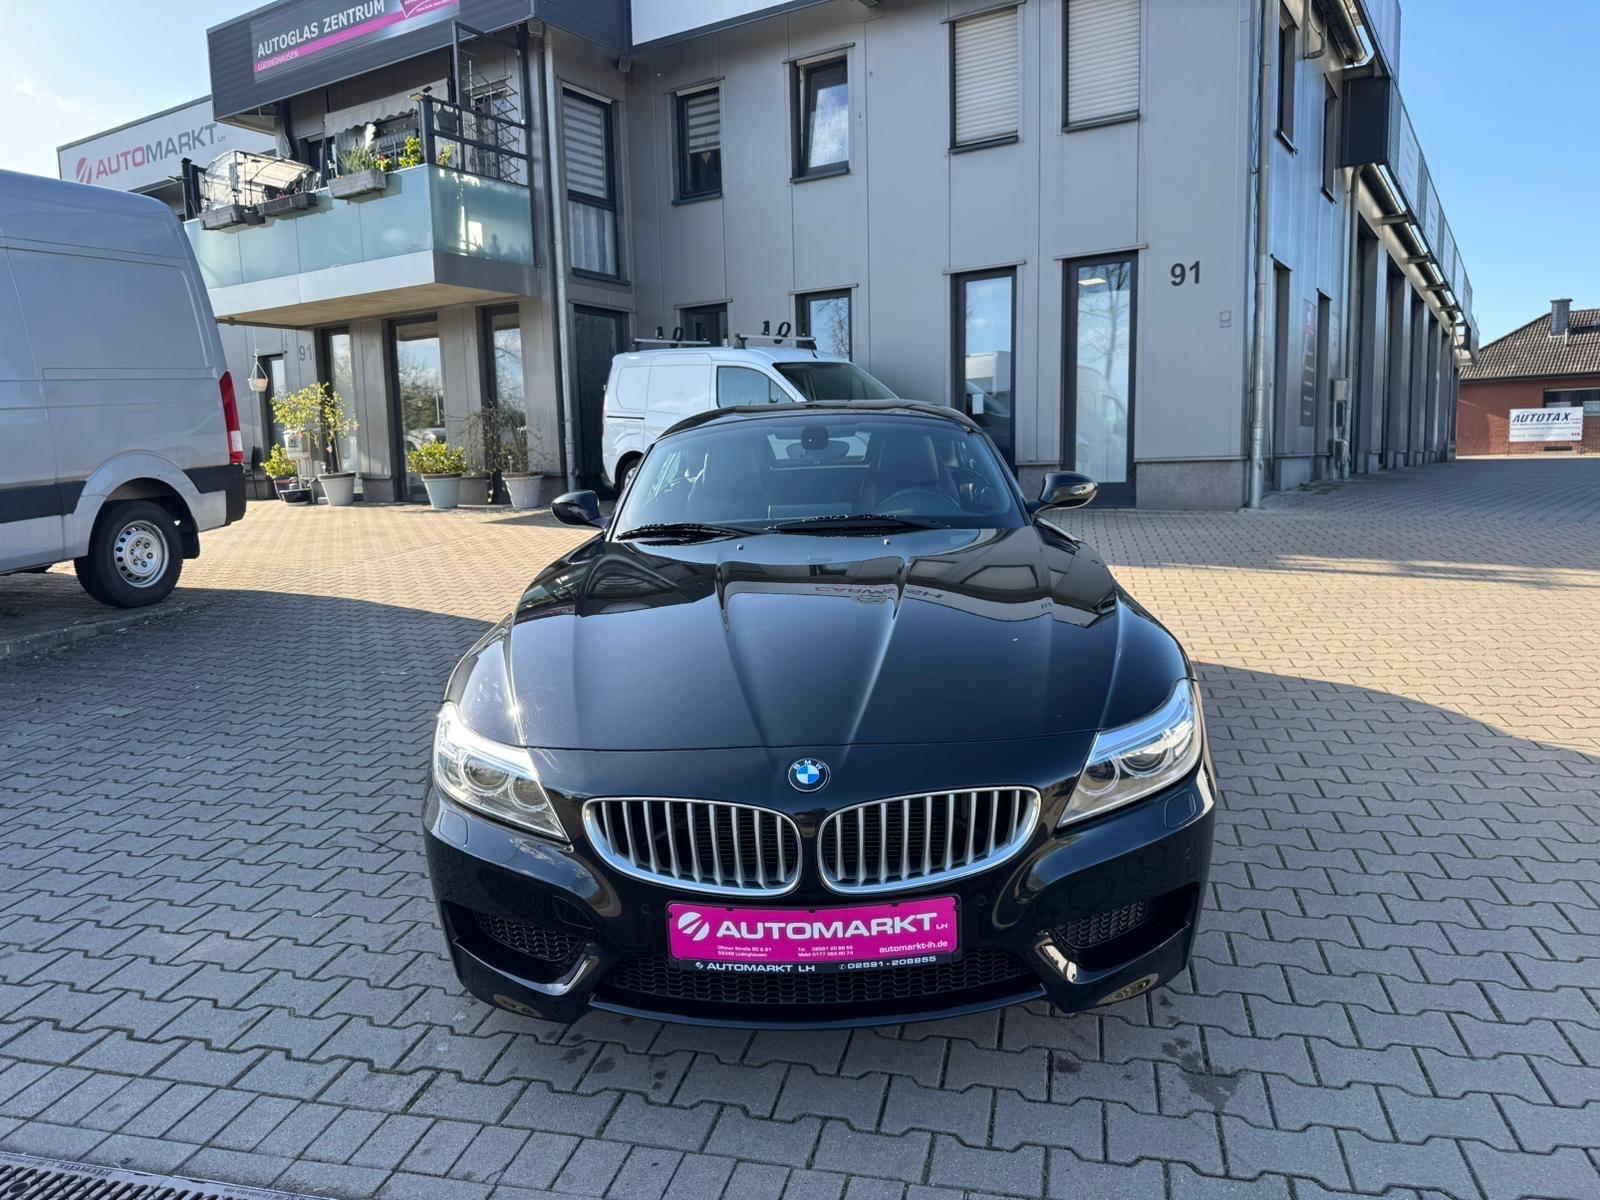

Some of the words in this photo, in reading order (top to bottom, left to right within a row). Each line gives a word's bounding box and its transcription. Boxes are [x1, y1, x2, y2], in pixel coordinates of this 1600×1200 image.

[257, 22, 319, 58] AUTOGLAS
[323, 0, 386, 33] ZENTRUM
[96, 122, 218, 179] AUTOMARKT
[1170, 260, 1200, 287] 91
[299, 344, 312, 361] 91
[1512, 412, 1571, 423] AUTOTAX
[793, 759, 823, 770] BMW
[716, 912, 938, 940] AUTOMARKT
[935, 922, 949, 930] LH
[706, 962, 793, 973] AUTOMARKT
[798, 964, 816, 973] LH
[847, 961, 884, 970] 02591
[891, 955, 937, 966] 208855
